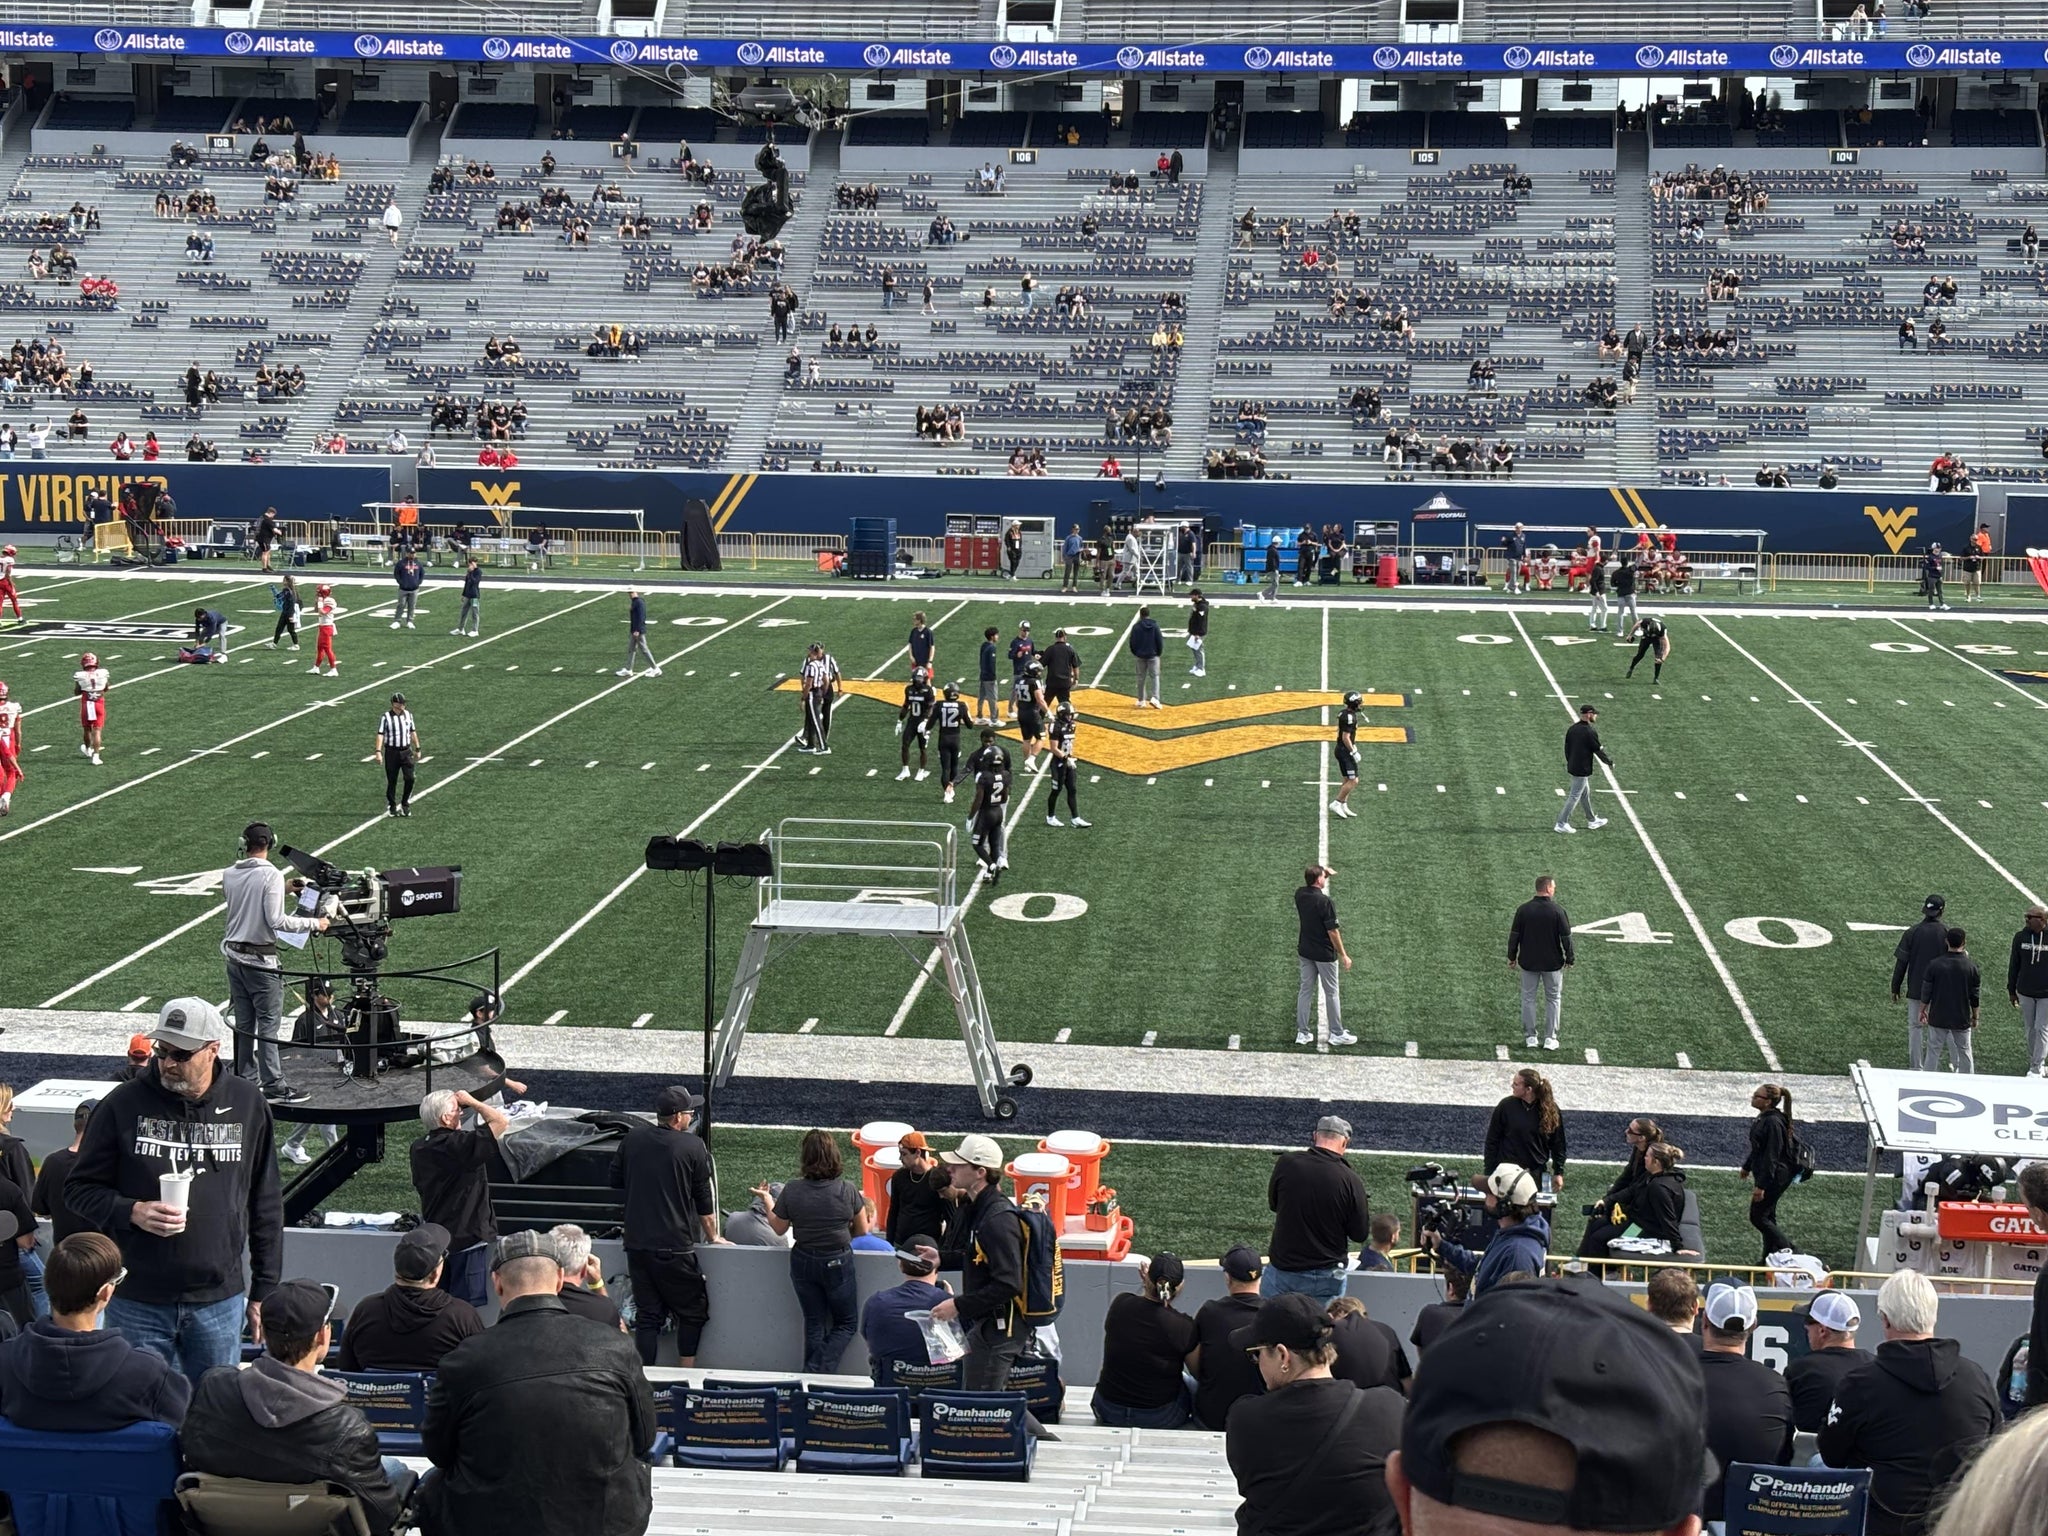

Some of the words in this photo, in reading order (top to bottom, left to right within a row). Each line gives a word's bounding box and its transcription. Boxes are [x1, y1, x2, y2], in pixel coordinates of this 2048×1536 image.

[124, 34, 184, 50] Allstate
[252, 37, 315, 53] Allstate
[383, 40, 444, 56] Allstate
[511, 42, 571, 58] Allstate
[639, 45, 698, 61] Allstate
[765, 47, 824, 63] Allstate
[892, 48, 951, 65] Allstate
[1018, 50, 1077, 66] Allstate
[1144, 50, 1205, 66] Allstate
[1272, 51, 1333, 67] Allstate
[1401, 51, 1462, 67] Allstate
[1530, 51, 1594, 67] Allstate
[1666, 50, 1728, 66] Allstate
[1799, 49, 1864, 65] Allstate
[1936, 48, 2002, 65] Allstate
[213, 138, 229, 148] 108
[1418, 153, 1434, 163] 105
[1836, 152, 1853, 162] 104
[941, 707, 959, 728] 12
[990, 781, 1004, 804] 2
[416, 891, 443, 901] SPORTS
[136, 1115, 177, 1142] WEST
[180, 1121, 243, 1144] VIRGINIA
[134, 1141, 163, 1158] COAL
[169, 1147, 205, 1162] NEVR
[349, 1381, 411, 1392] Panhandle
[702, 1397, 766, 1405] Panhandle
[823, 1401, 887, 1413] Panhandle
[948, 1407, 1012, 1418] Panhandle
[1772, 1478, 1855, 1495] Panhandle
[1771, 1490, 1801, 1500] CLEANING
